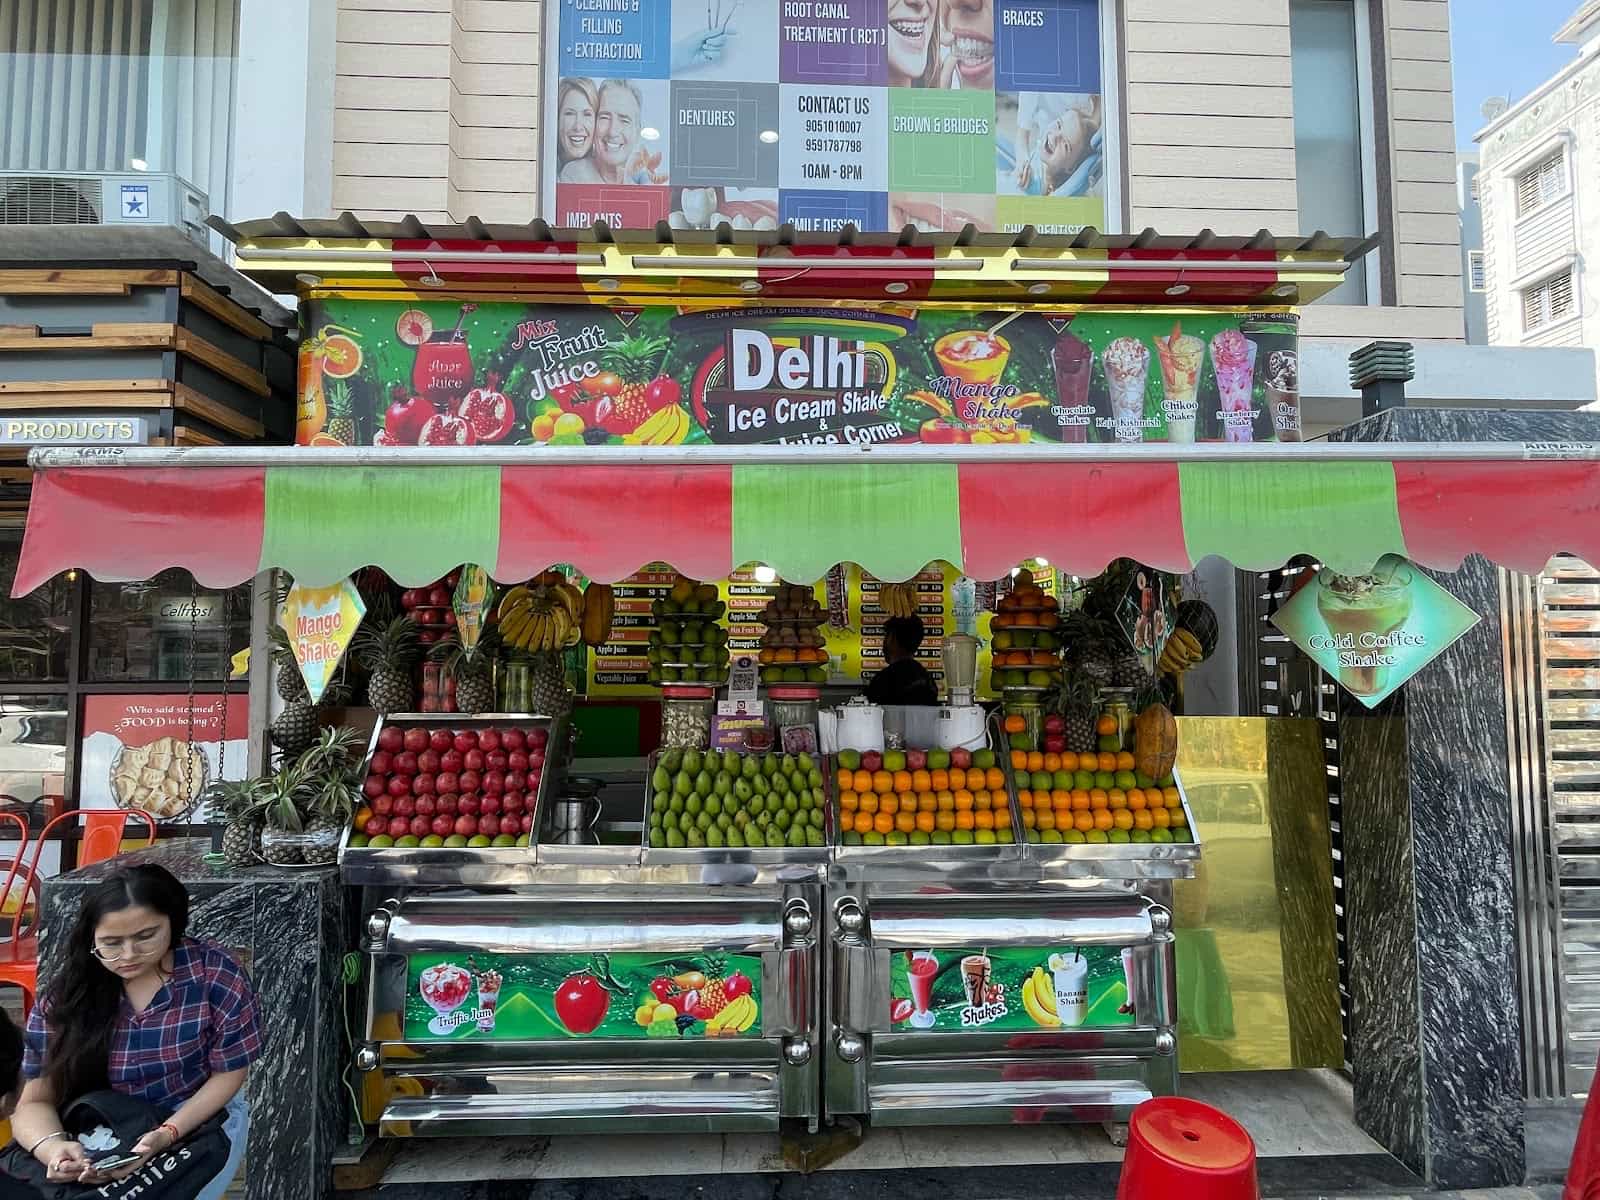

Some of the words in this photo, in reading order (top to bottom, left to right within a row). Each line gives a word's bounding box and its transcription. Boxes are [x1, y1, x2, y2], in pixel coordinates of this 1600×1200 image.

[576, 0, 629, 11] CLEANING
[784, 2, 813, 17] ROOT
[815, 3, 850, 19] CANAL
[582, 18, 622, 34] FILLING
[1003, 10, 1044, 26] BRACES
[784, 26, 848, 43] TREATMENT
[575, 42, 642, 59] EXTRACTION
[798, 96, 852, 114] CONTACT
[854, 97, 870, 114] US
[680, 109, 735, 126] DENTURES
[894, 116, 931, 133] CROWN
[944, 118, 989, 134] BRIDGES
[801, 163, 830, 179] 10AM
[840, 164, 862, 180] 8PM
[511, 320, 559, 350] Mix
[529, 325, 608, 371] Fruit
[731, 328, 865, 391] Delhi
[530, 361, 600, 401] Juice
[929, 375, 1020, 404] Mango
[728, 403, 767, 432] Ice
[775, 397, 836, 424] Cream
[842, 390, 886, 415] Shake
[963, 400, 1023, 420] Shake
[1051, 405, 1096, 416] Chocolate
[1161, 400, 1199, 411] Chikoo
[819, 417, 828, 431] &
[1057, 416, 1090, 425] Shakes
[1165, 412, 1195, 422] Shakes
[7, 421, 134, 440] PRODUCTS
[843, 421, 903, 445] Corner
[296, 612, 342, 637] Mango
[1309, 633, 1355, 649] Cold
[1359, 631, 1425, 648] Coffee
[298, 640, 339, 664] Shake
[1339, 651, 1396, 667] Shake
[126, 705, 153, 714] Who
[155, 705, 174, 713] said
[177, 705, 214, 713] stemed
[120, 717, 165, 727] FOOD
[177, 718, 208, 727] boing
[437, 1011, 470, 1027] Traffic
[471, 1008, 492, 1020] Jam
